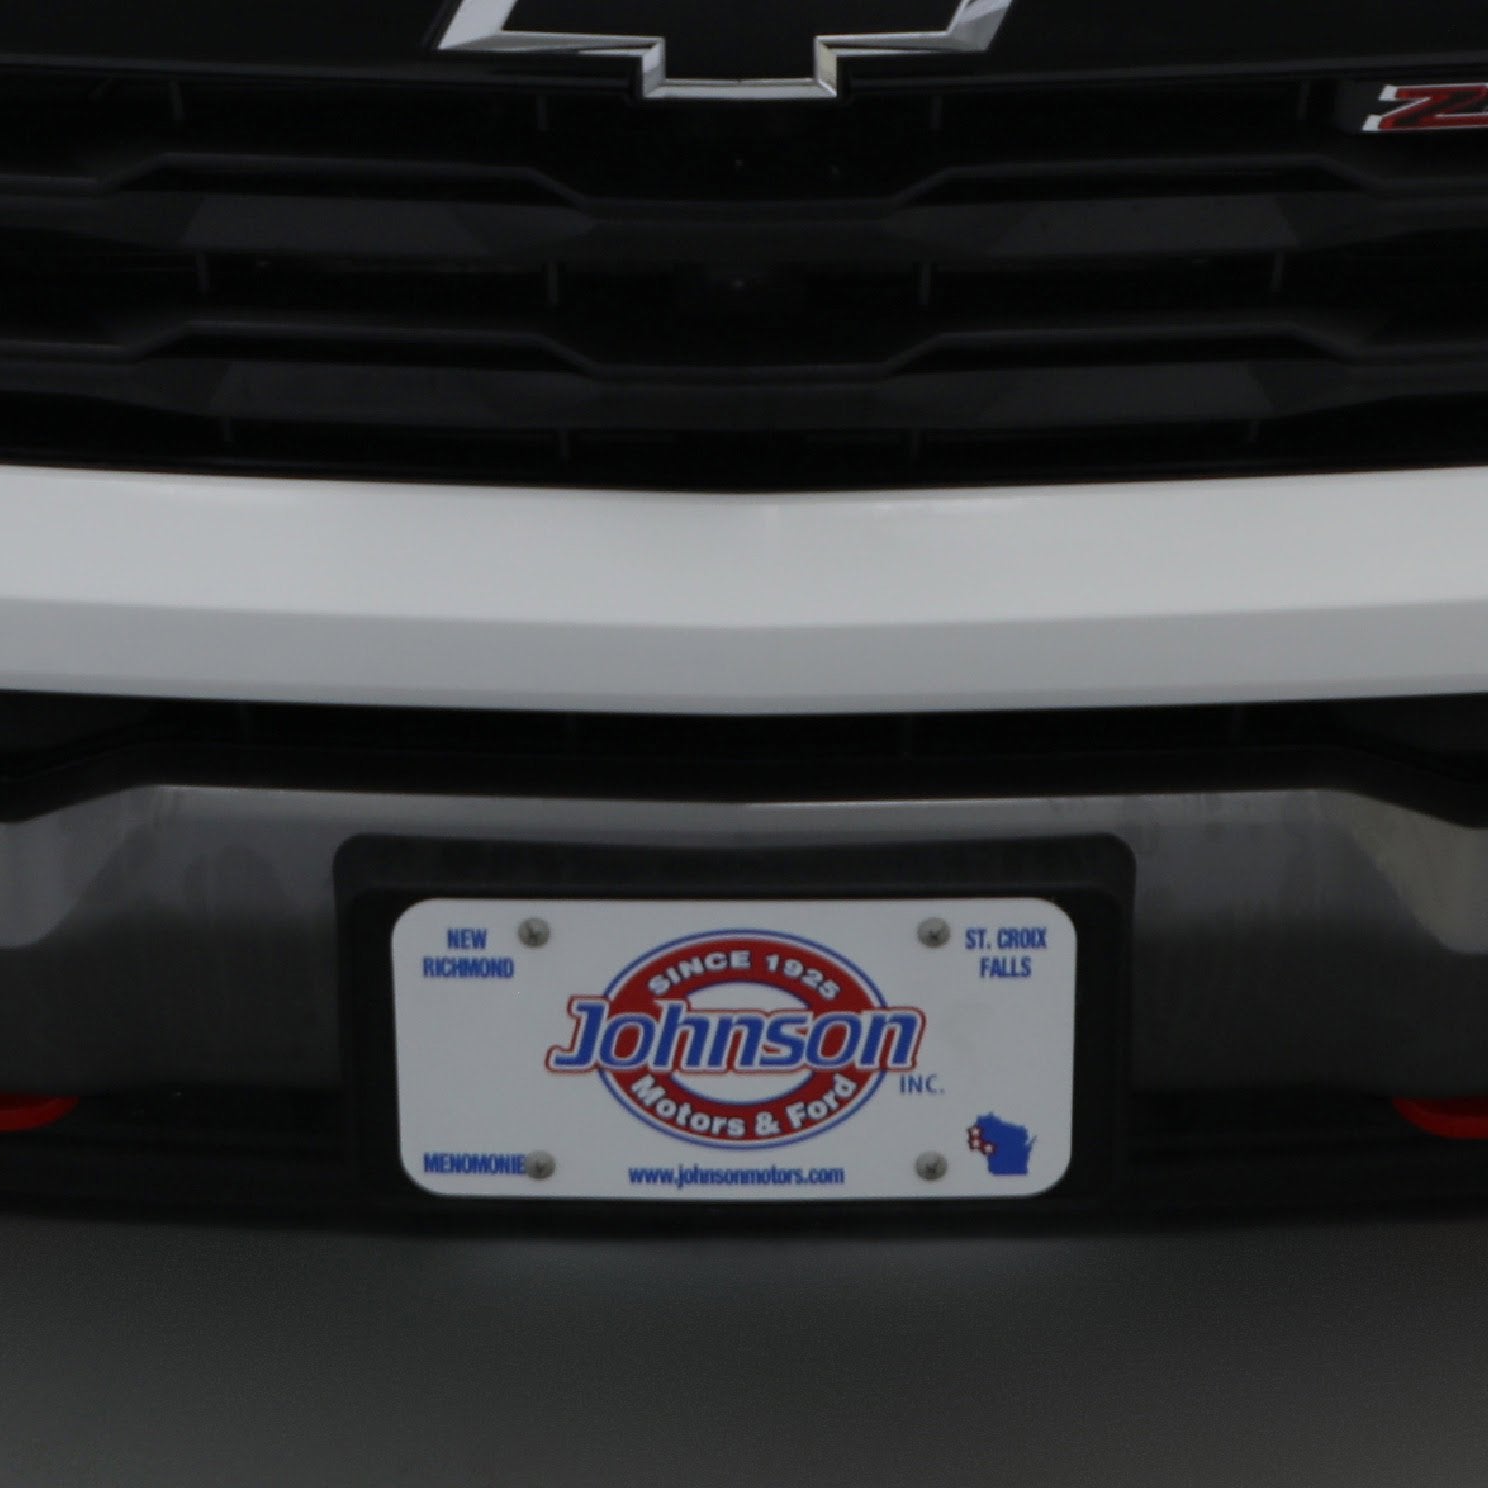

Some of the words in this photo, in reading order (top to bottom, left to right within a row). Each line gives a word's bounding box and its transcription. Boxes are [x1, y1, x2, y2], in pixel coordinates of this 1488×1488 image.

[448, 929, 487, 949] NEW
[965, 927, 990, 949] ST.
[998, 927, 1047, 949] CROIX
[423, 957, 514, 978] RICHMOND
[648, 950, 751, 995] SINCE
[765, 954, 841, 999] 1925
[980, 956, 1031, 978] FALLS
[548, 998, 925, 1071] Johnson
[900, 1073, 945, 1093] INC.
[631, 1074, 745, 1136] Motors
[755, 1111, 781, 1136] &
[785, 1073, 857, 1129] Ford
[423, 1153, 528, 1174] MENOMONIE
[628, 1163, 846, 1188] www.johnsonmotors.com
